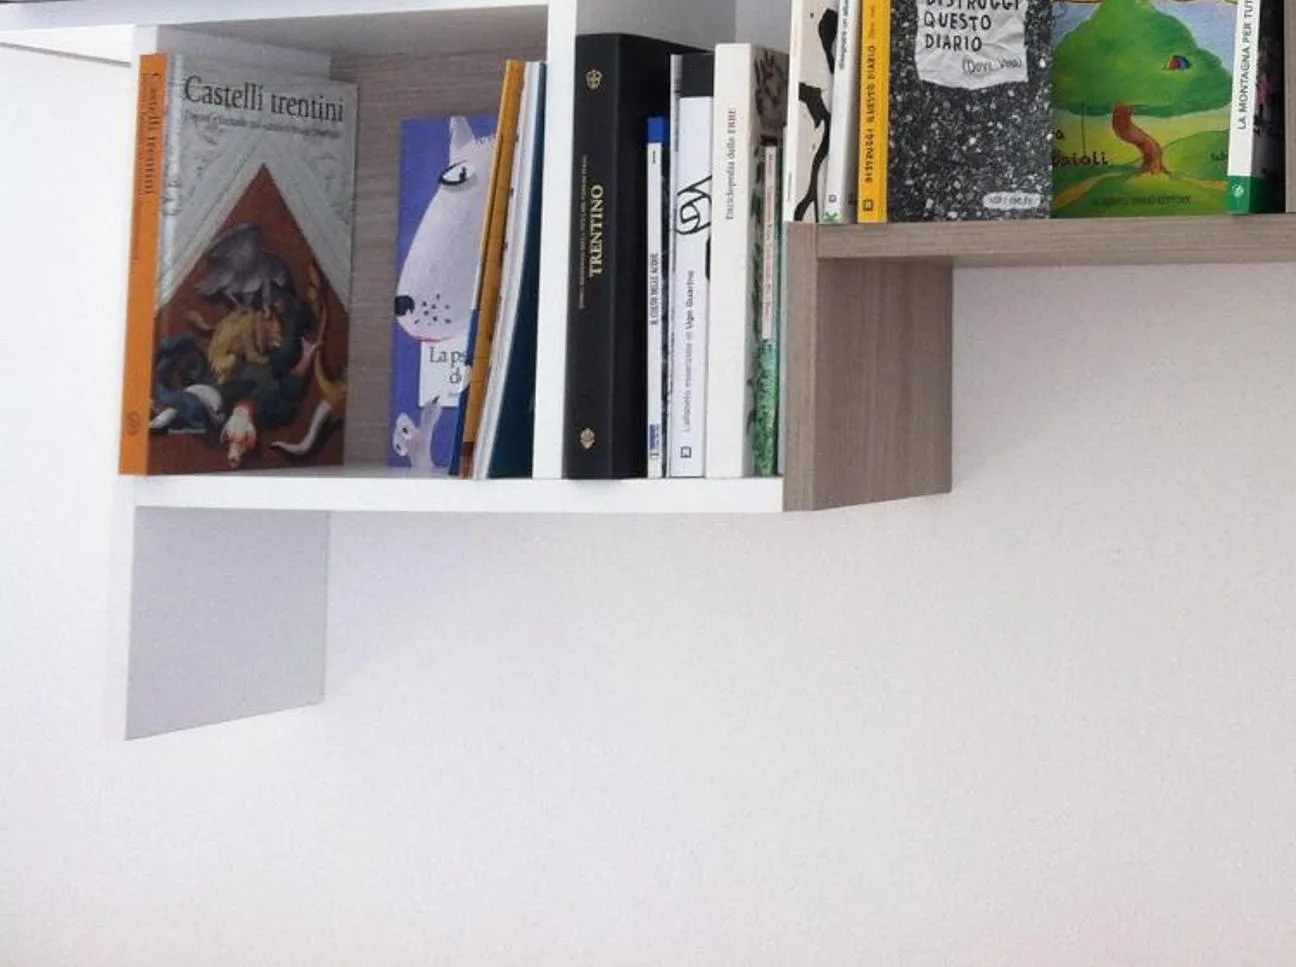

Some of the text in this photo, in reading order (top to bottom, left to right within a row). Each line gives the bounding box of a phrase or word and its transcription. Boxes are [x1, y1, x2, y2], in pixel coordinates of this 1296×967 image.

[924, 11, 992, 31] QUESTO
[925, 34, 983, 52] DIARIO
[1243, 24, 1252, 44] PER
[1239, 45, 1251, 112] MONTAGNA
[183, 74, 344, 122] Castelli trentini
[1237, 113, 1247, 130] LA
[589, 185, 604, 278] TRENTINO
[429, 346, 447, 363] La
